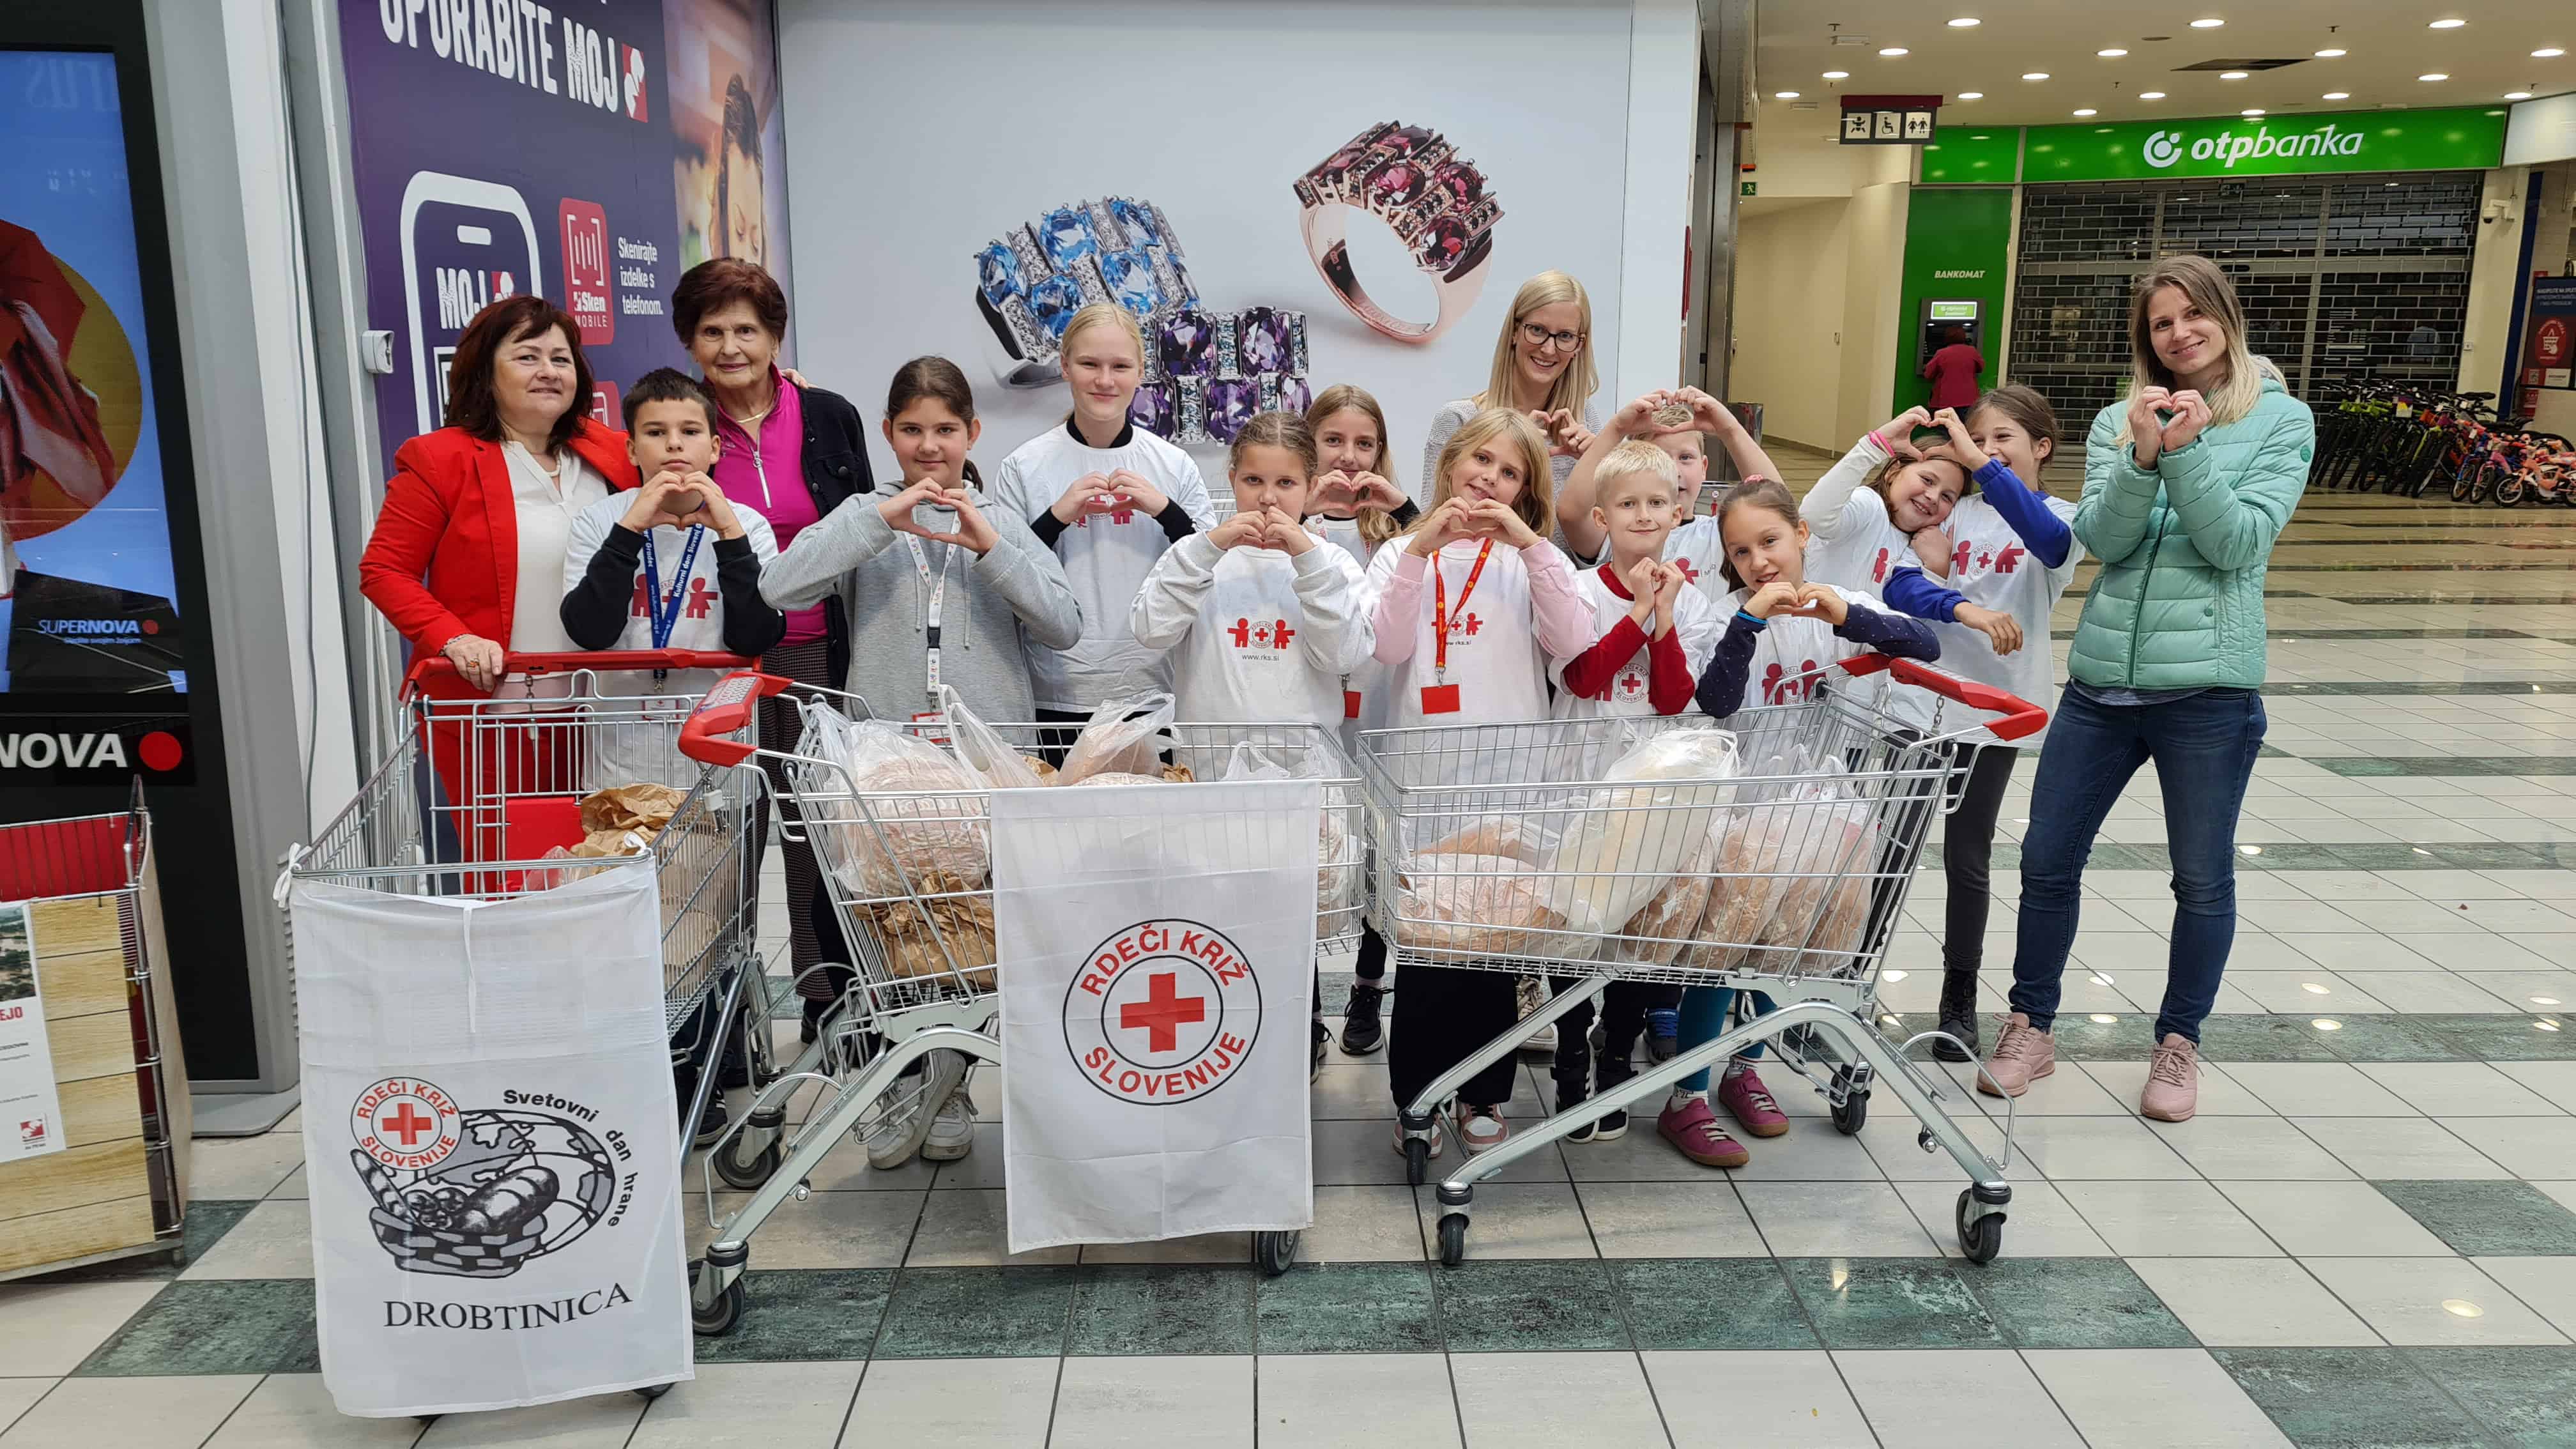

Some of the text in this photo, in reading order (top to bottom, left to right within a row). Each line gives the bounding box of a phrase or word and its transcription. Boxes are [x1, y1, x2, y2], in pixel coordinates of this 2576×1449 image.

[563, 17, 618, 113] MOJ
[2191, 124, 2365, 169] otpbanka
[618, 236, 658, 265] Skenirajte
[620, 266, 655, 288] izdelke s
[1934, 270, 1986, 279] BANKOMAT
[436, 266, 488, 330] MOJ
[622, 295, 664, 315] telefonom.
[575, 315, 608, 327] MOBILE
[645, 542, 654, 567] Gradec
[673, 569, 687, 597] Kulturni
[682, 554, 693, 569] dom
[38, 619, 140, 634] SUPERNOVA
[1080, 924, 1249, 995] RDEČI KRIŽ
[1084, 1032, 1246, 1096] SLOVENIJE
[356, 1080, 457, 1119] RDEČI KRIŽ
[361, 1135, 457, 1168] SLOVENIJE
[503, 1089, 639, 1227] Svetovni dan hrane
[383, 1282, 634, 1330] DROBTINICA
